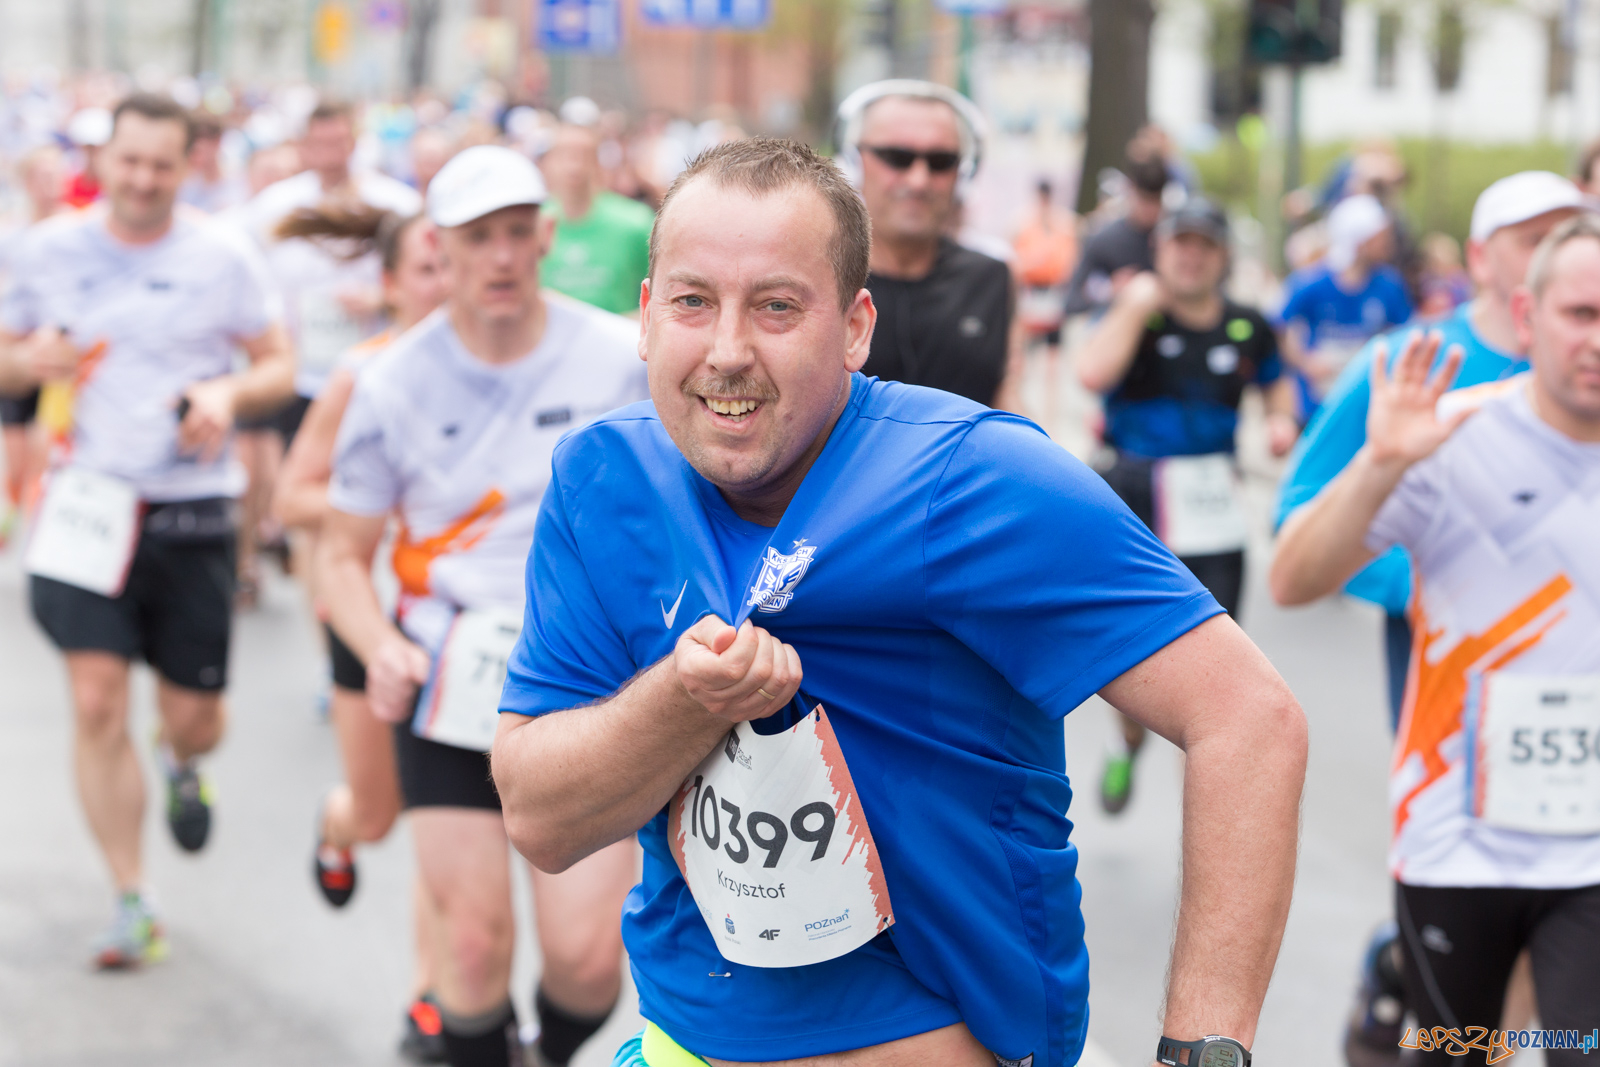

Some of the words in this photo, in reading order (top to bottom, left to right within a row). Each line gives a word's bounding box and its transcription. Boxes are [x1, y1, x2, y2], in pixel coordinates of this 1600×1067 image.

[691, 774, 836, 869] 10399
[716, 868, 786, 899] Krzysztof
[758, 928, 781, 941] 4F
